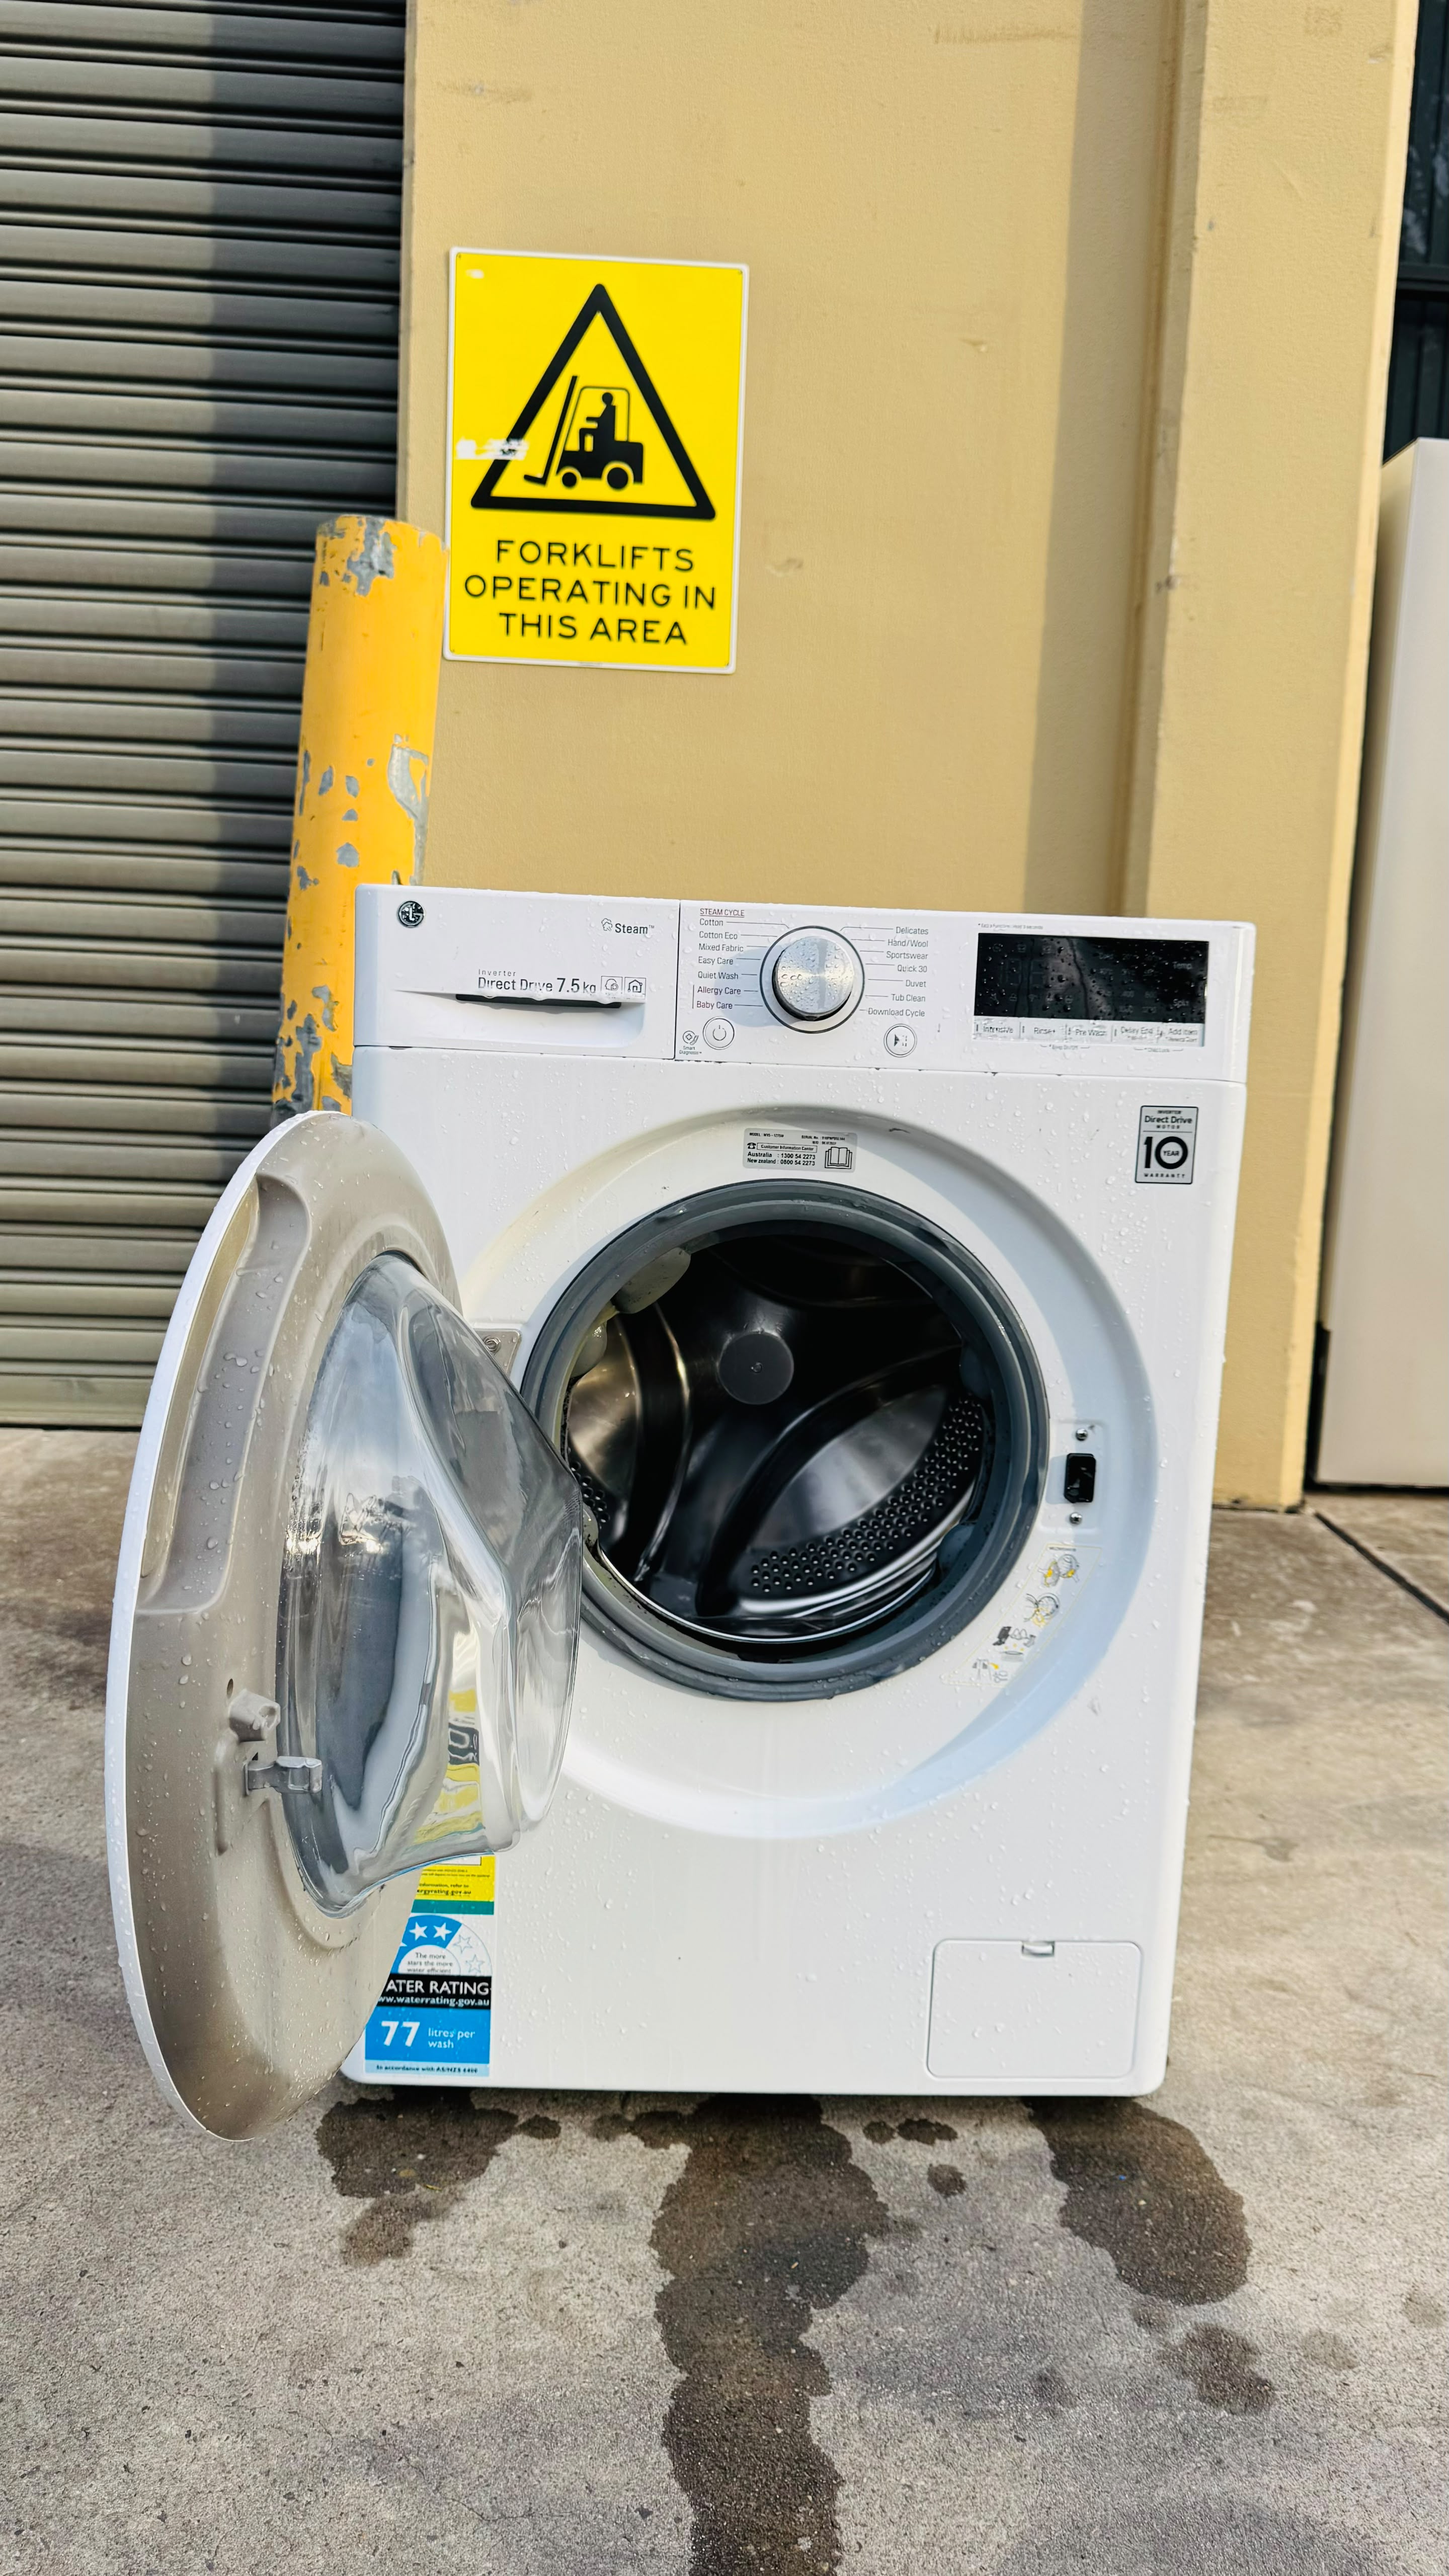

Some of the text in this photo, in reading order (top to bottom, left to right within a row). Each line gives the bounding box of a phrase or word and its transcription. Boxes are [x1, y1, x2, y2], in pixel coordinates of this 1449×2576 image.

[497, 540, 694, 573] FORKLIFTS
[464, 575, 716, 610] OPERATING IN
[499, 612, 687, 646] THIS AREA
[699, 931, 723, 939] Cotton
[896, 926, 929, 935] Delicates
[698, 943, 744, 952] Mixed Fabric
[888, 939, 929, 947] Hand/Wool
[886, 951, 929, 959] Sportswear
[698, 956, 715, 965] Easy
[478, 969, 517, 977] Inverter
[897, 964, 917, 973] Quick
[698, 971, 739, 980] Quiet Wash
[478, 977, 517, 991] Direct
[556, 978, 580, 993] 7.5
[905, 980, 926, 988] Duvet
[697, 986, 741, 996] Allergy Care
[891, 993, 926, 1002] Tub Clean
[696, 1000, 733, 1010] Baby Care
[868, 1007, 925, 1018] Download Cycle
[1144, 1136, 1188, 1170] 10
[385, 1979, 489, 1996] ATER RATING
[378, 1995, 490, 2007] ww.waterrating.gov.au
[381, 2020, 421, 2047] 77
[428, 2027, 475, 2041] litres per
[428, 2039, 454, 2049] wash
